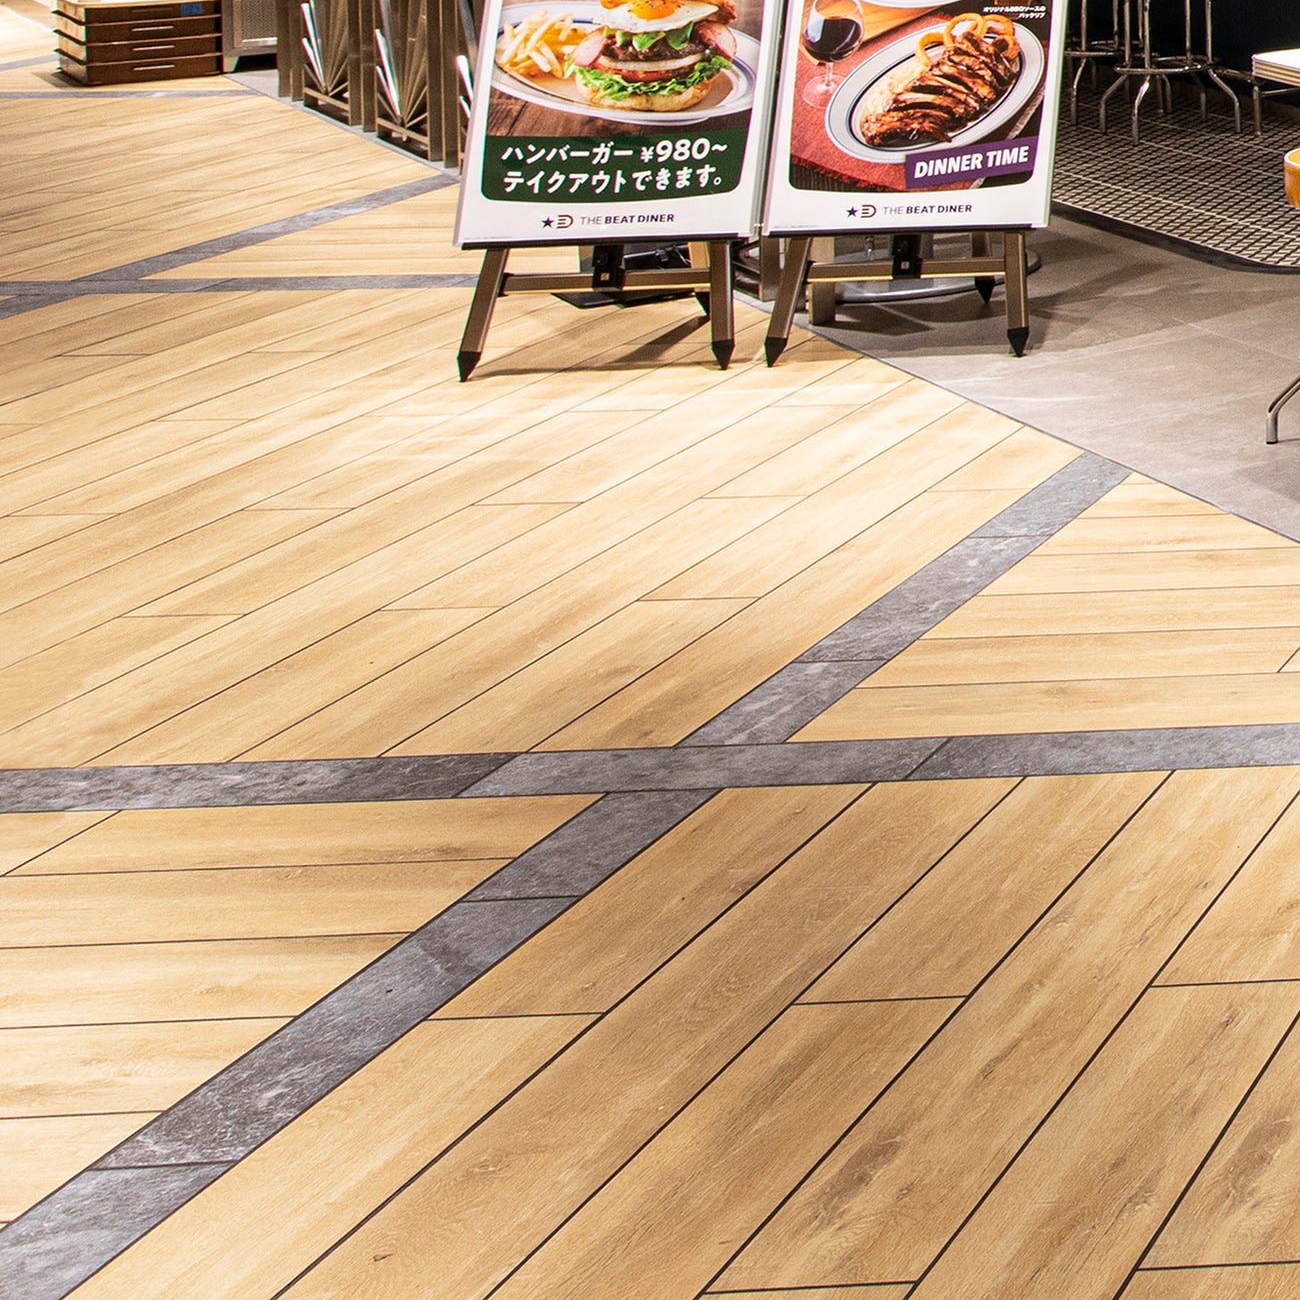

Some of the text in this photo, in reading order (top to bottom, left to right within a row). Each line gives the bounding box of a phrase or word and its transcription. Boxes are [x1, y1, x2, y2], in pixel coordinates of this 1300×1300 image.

[501, 142, 633, 165] ハンバーガー
[914, 146, 1030, 178] DINNER TIME
[503, 164, 721, 194] テイクアウトできます。
[580, 213, 675, 225] THE BEAT DINER
[883, 205, 973, 215] THE BEAT DINER
